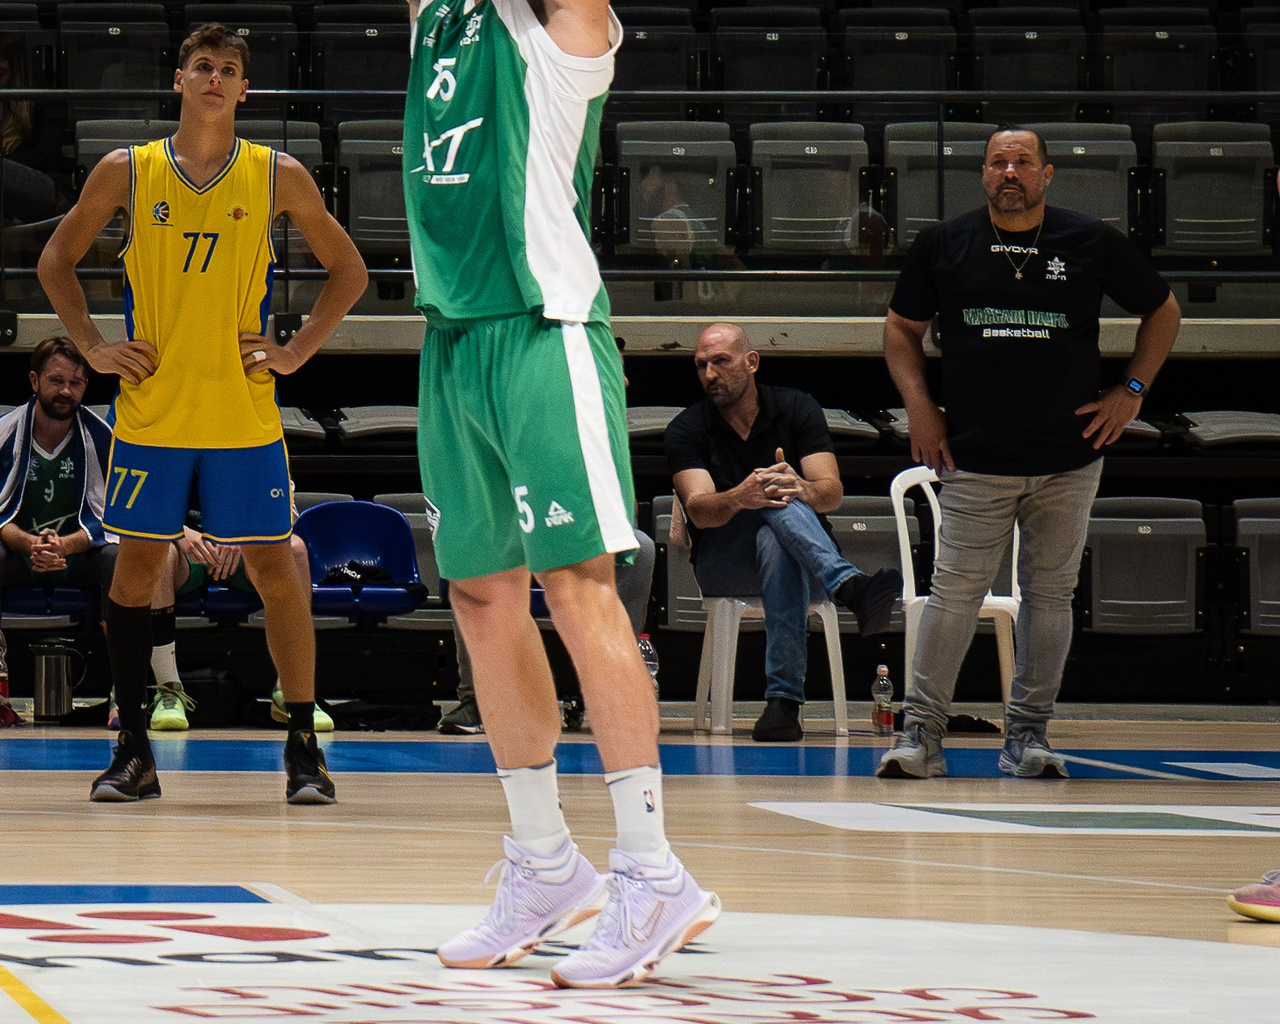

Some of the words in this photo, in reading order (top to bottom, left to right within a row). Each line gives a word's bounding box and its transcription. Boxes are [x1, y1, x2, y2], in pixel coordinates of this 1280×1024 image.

[183, 232, 220, 273] 77
[982, 328, 1051, 339] Basketball
[109, 466, 149, 509] 77
[148, 987, 1039, 1018] משקפיים
